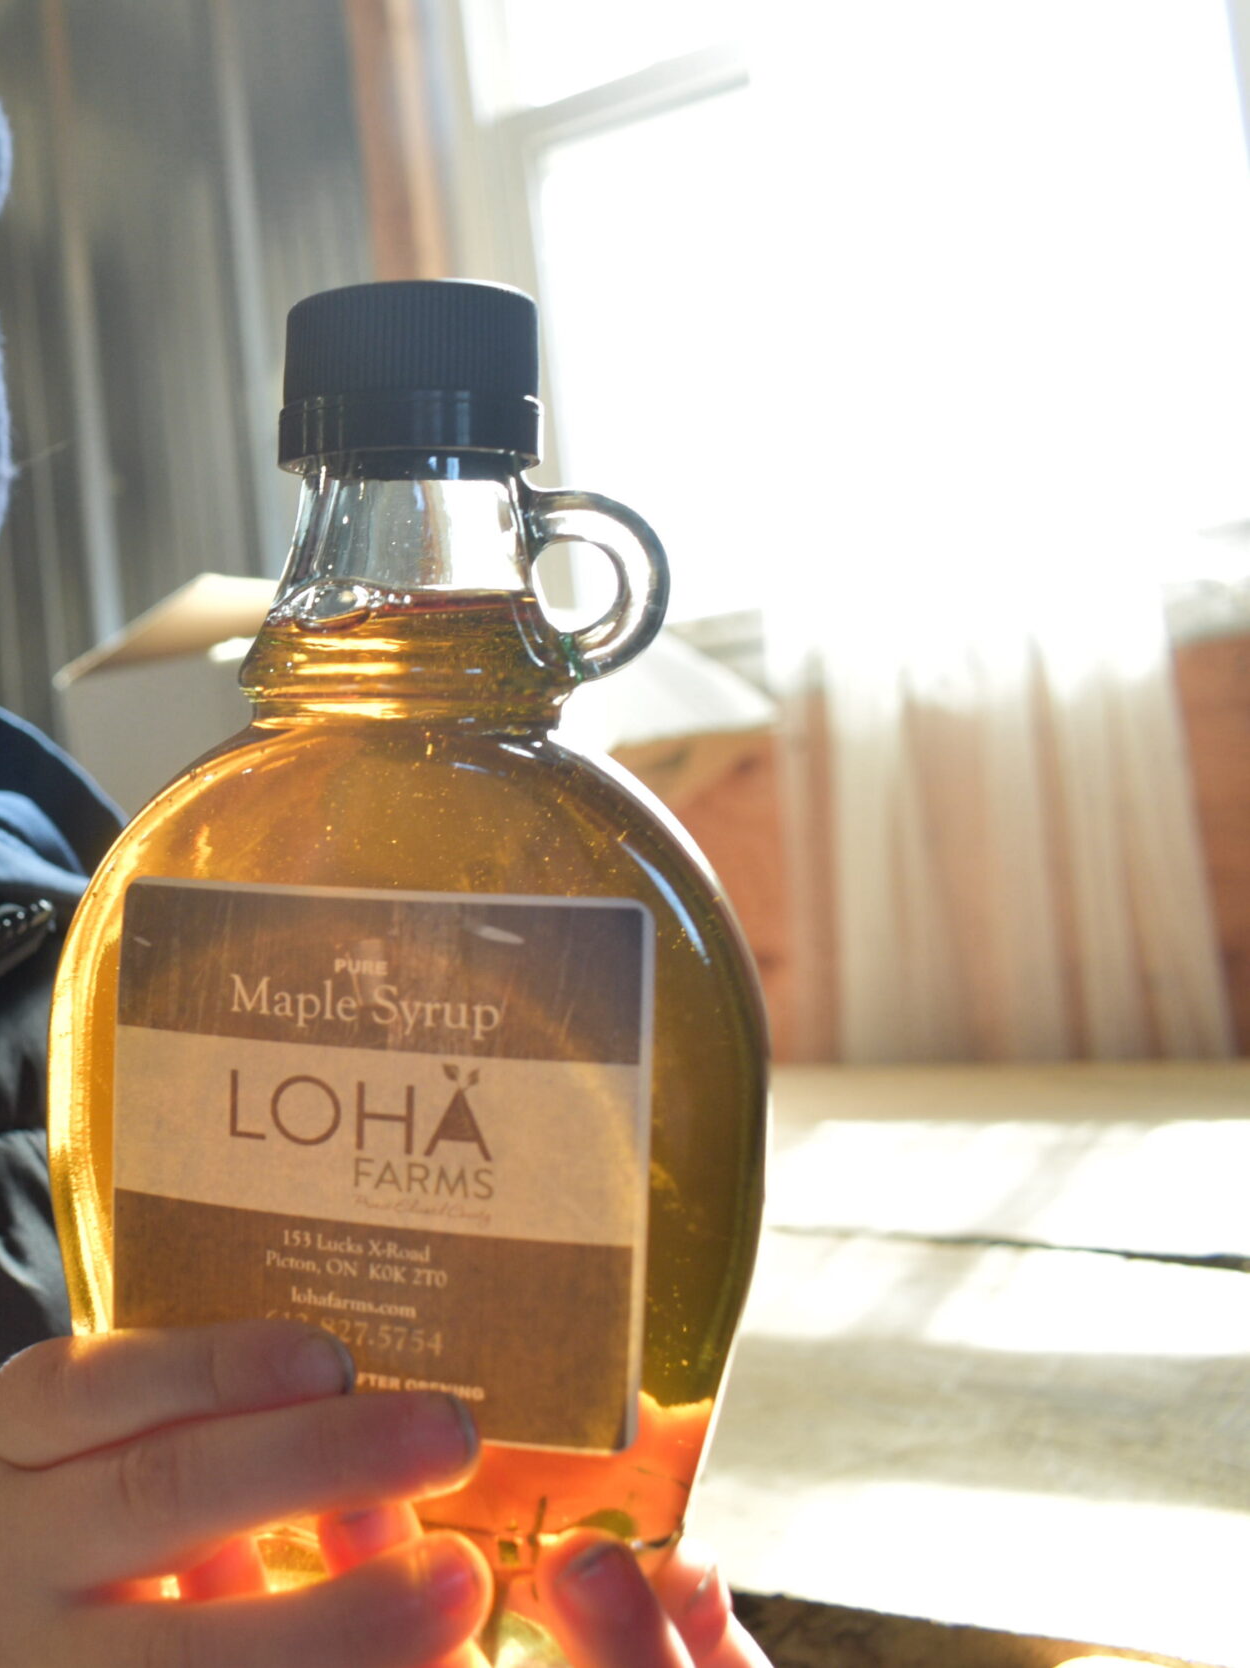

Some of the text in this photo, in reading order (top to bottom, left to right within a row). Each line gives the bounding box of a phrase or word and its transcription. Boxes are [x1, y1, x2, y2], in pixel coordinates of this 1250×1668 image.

[334, 958, 388, 976] PURE
[230, 973, 499, 1040] Maple Syrup
[230, 1066, 492, 1161] LOHA
[353, 1157, 495, 1200] FARMS
[283, 1229, 431, 1263] 153 Lucks X-Road
[265, 1250, 321, 1275] Picton,
[326, 1258, 358, 1277] ON
[291, 1285, 417, 1319] lohafarms.com
[356, 1371, 400, 1390] FTER
